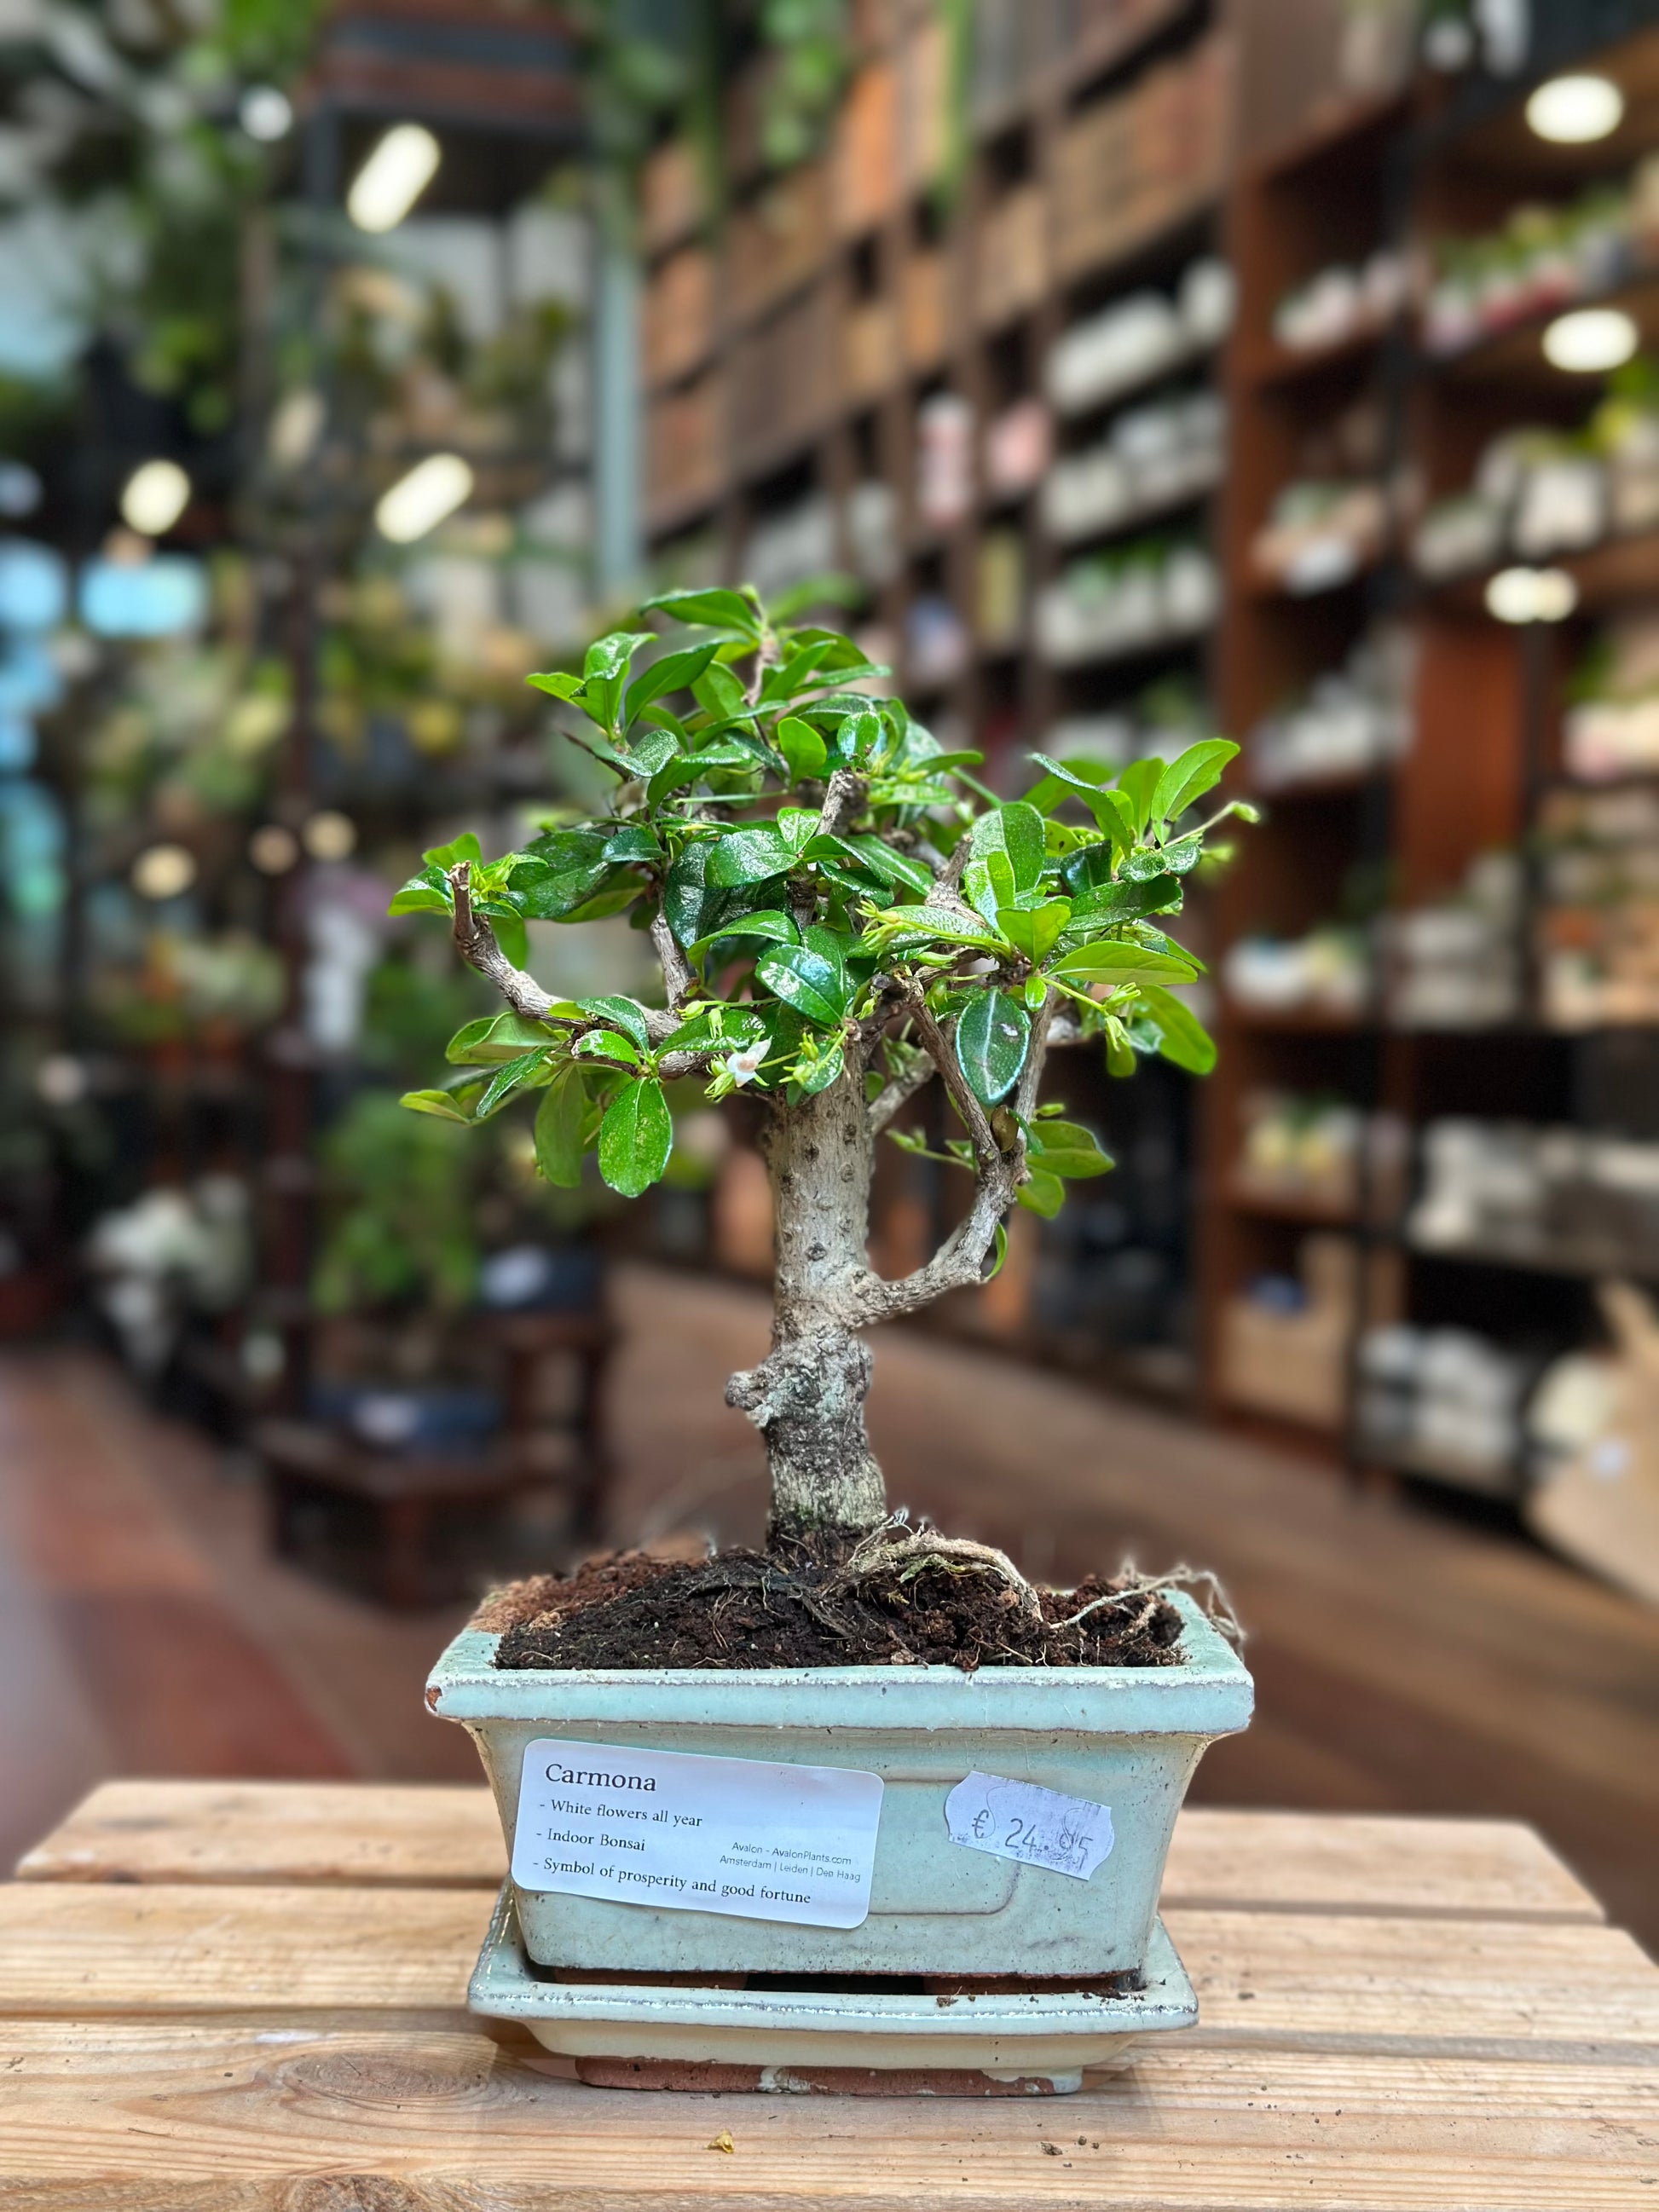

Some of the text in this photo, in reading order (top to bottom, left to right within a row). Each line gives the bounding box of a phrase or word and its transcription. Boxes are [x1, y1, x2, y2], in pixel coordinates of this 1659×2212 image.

[545, 1763, 656, 1792] Carmona
[551, 1799, 592, 1816] White
[596, 1804, 648, 1820] flowers
[652, 1810, 668, 1822] all
[673, 1815, 702, 1828] year
[971, 1809, 990, 1839] €
[547, 1828, 594, 1845] Indoor
[600, 1834, 645, 1851] Bonsai
[731, 1841, 763, 1854] Avalon
[772, 1847, 852, 1865] AvalonPlants.com
[544, 1857, 594, 1874] Symbol
[599, 1865, 616, 1878] of
[617, 1870, 687, 1891] prosperity
[691, 1879, 716, 1892] and
[721, 1884, 755, 1897] good
[760, 1886, 811, 1903] fortune
[720, 1855, 772, 1869] Amsterdam
[779, 1863, 808, 1874] Leiden
[816, 1867, 834, 1878] Den
[836, 1870, 861, 1882] Haag
